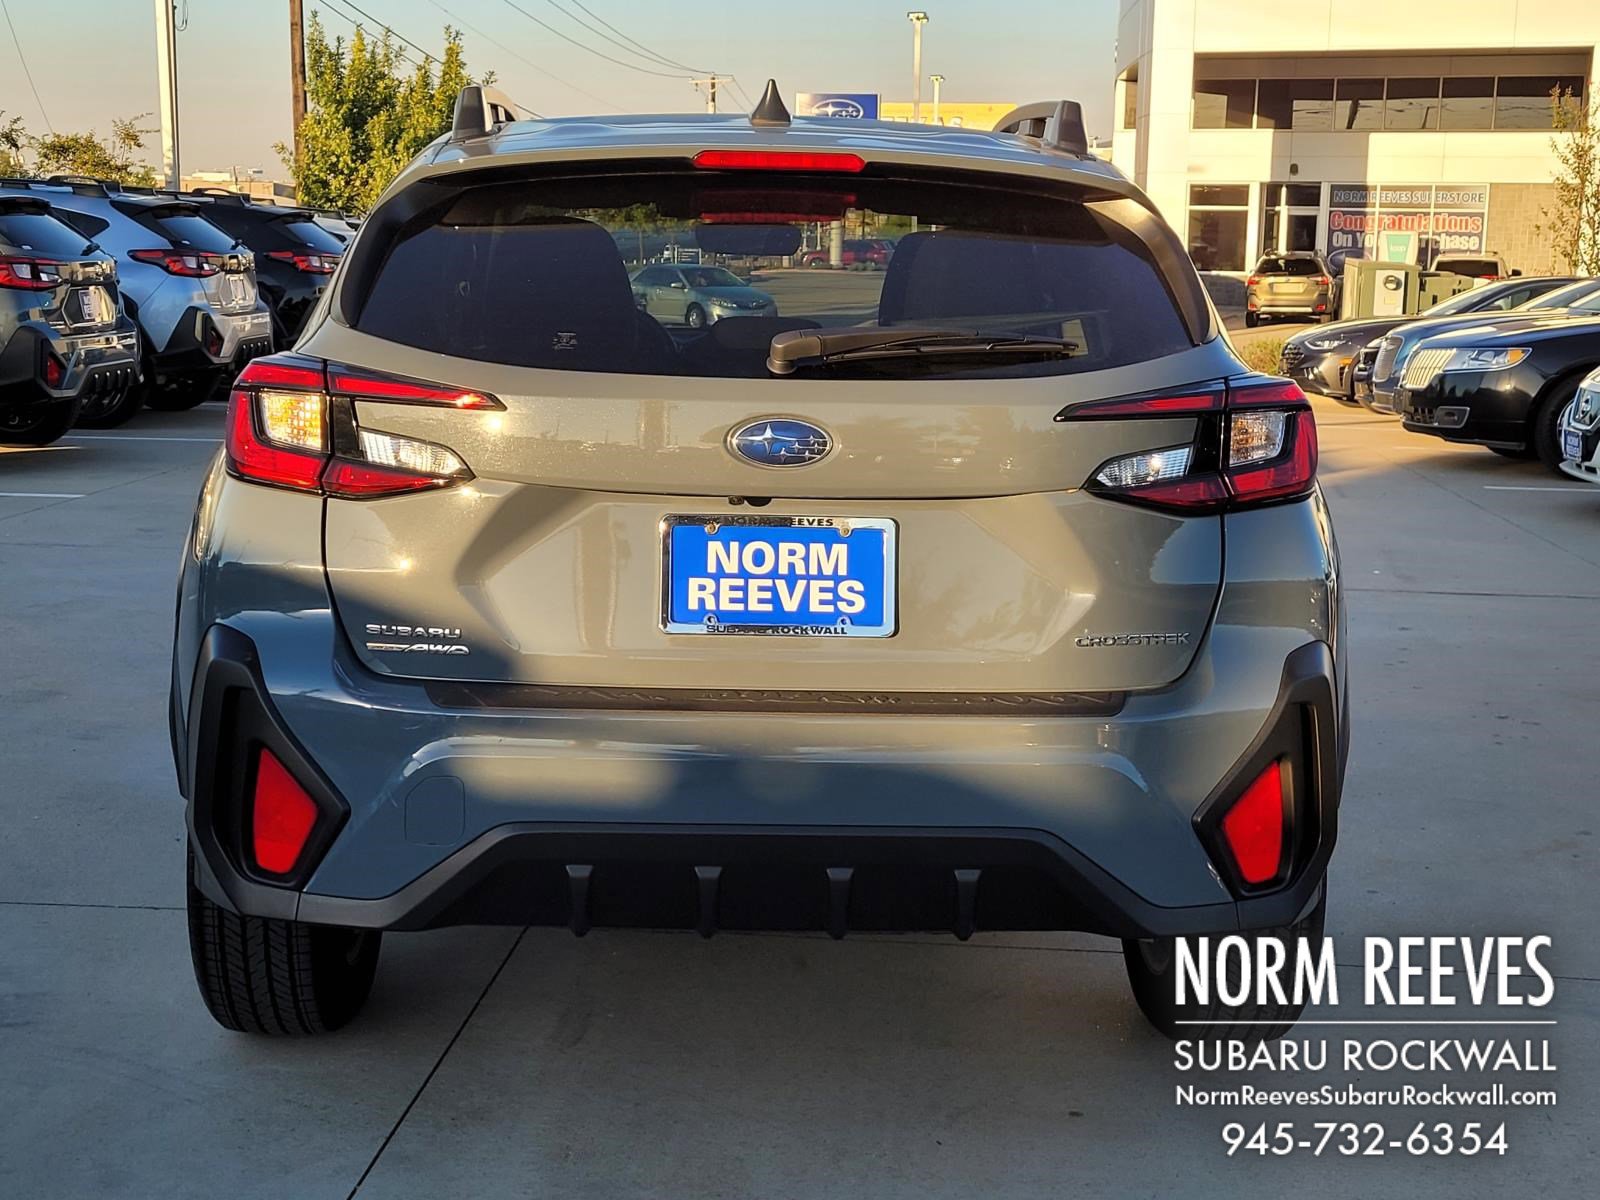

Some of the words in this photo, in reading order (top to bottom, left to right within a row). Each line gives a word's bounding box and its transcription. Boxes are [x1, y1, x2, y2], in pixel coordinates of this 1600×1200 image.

[1334, 191, 1367, 202] NORM
[1371, 191, 1411, 203] REEVES
[1413, 191, 1485, 203] SUPERSTORE
[1330, 212, 1482, 233] Congratulations
[1332, 231, 1352, 247] On
[775, 517, 833, 527] REEVES
[706, 541, 848, 576] NORM
[687, 577, 866, 613] REEVES
[365, 623, 463, 639] SUBARU
[770, 626, 848, 635] ROCKWALL
[1074, 632, 1191, 648] CROSSTREK
[404, 643, 470, 656] AWD
